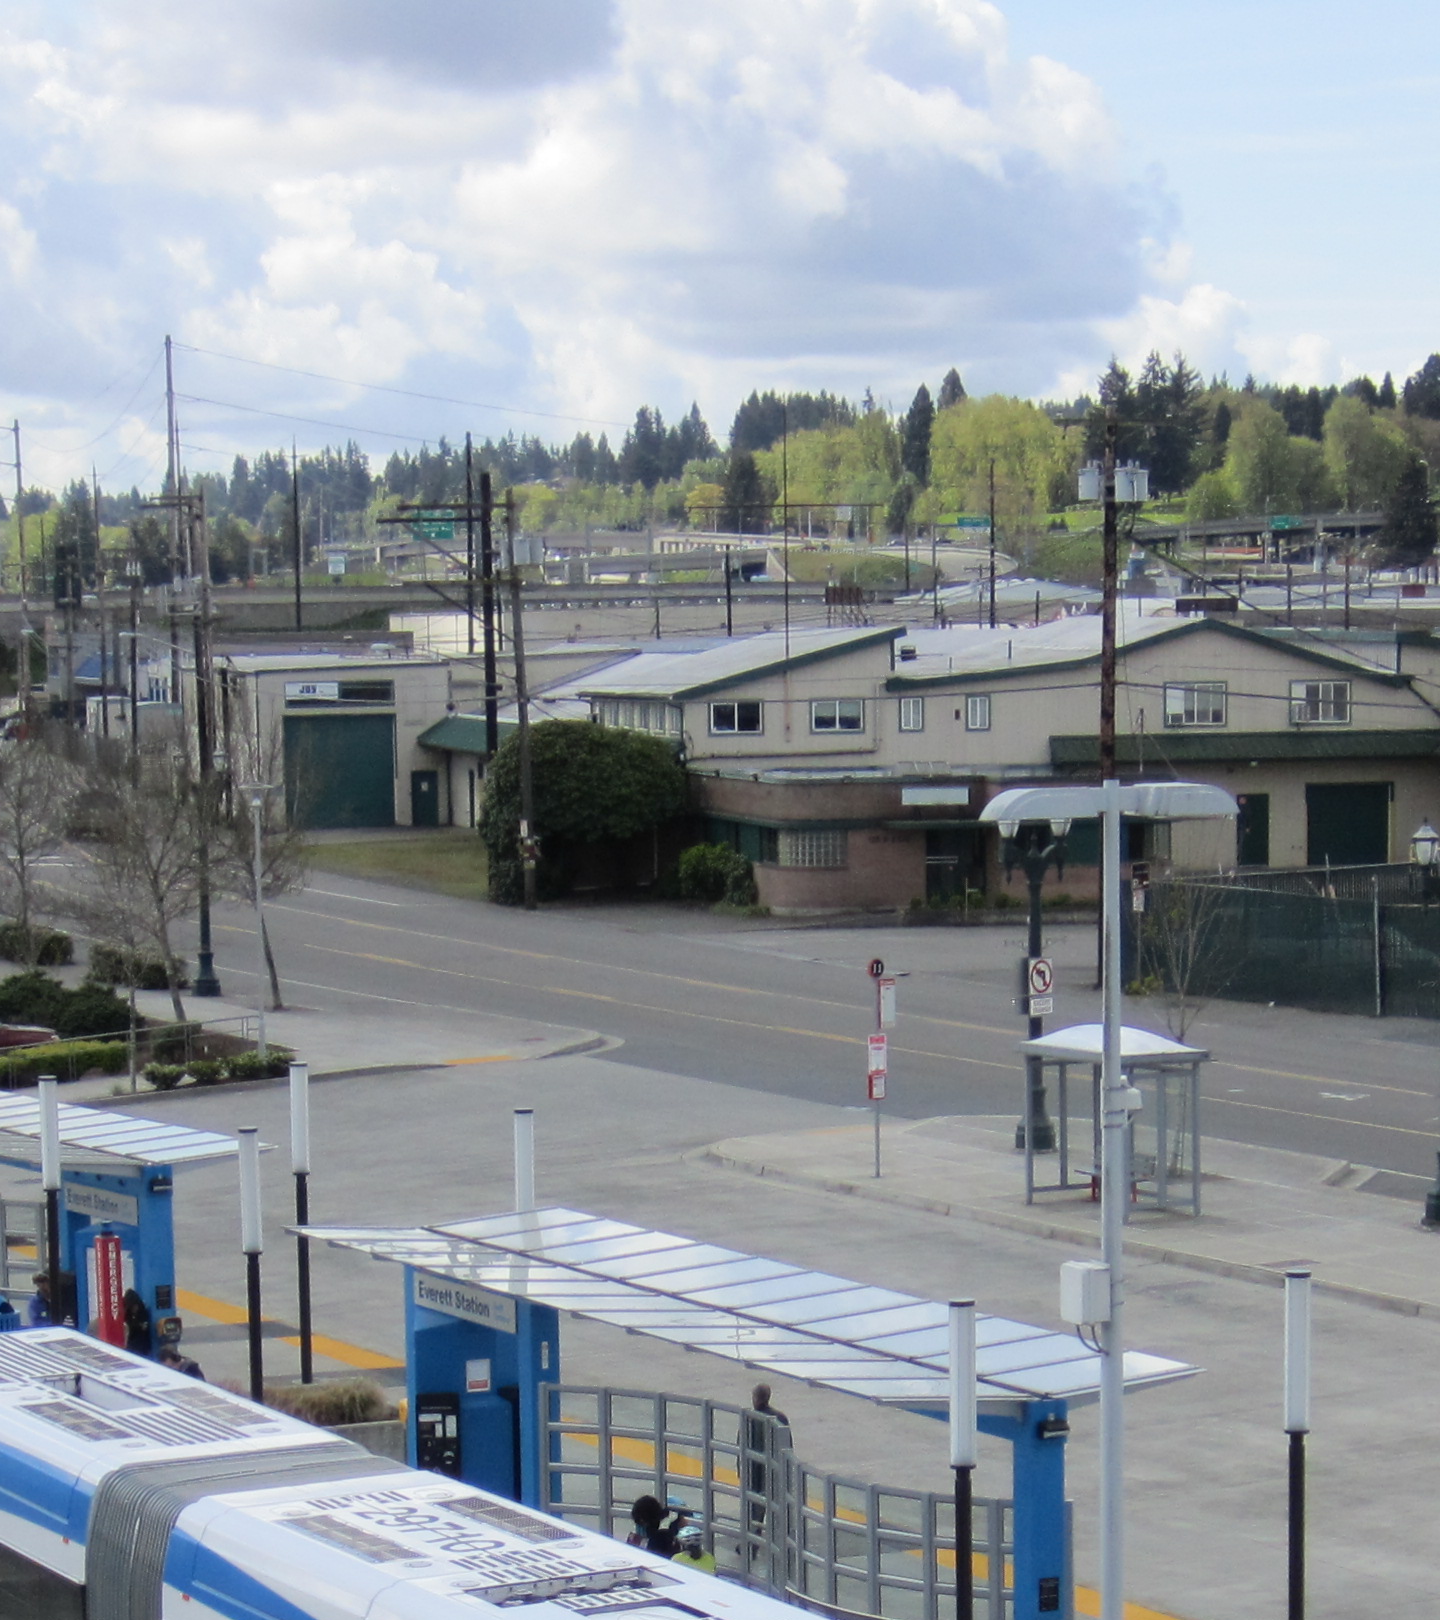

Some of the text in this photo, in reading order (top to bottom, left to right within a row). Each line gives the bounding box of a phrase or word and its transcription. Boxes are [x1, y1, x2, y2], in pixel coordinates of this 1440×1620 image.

[108, 1240, 119, 1320] EMERGENCY
[418, 1280, 453, 1307] Everett
[454, 1290, 491, 1318] Station
[352, 1506, 506, 1553] 29710
